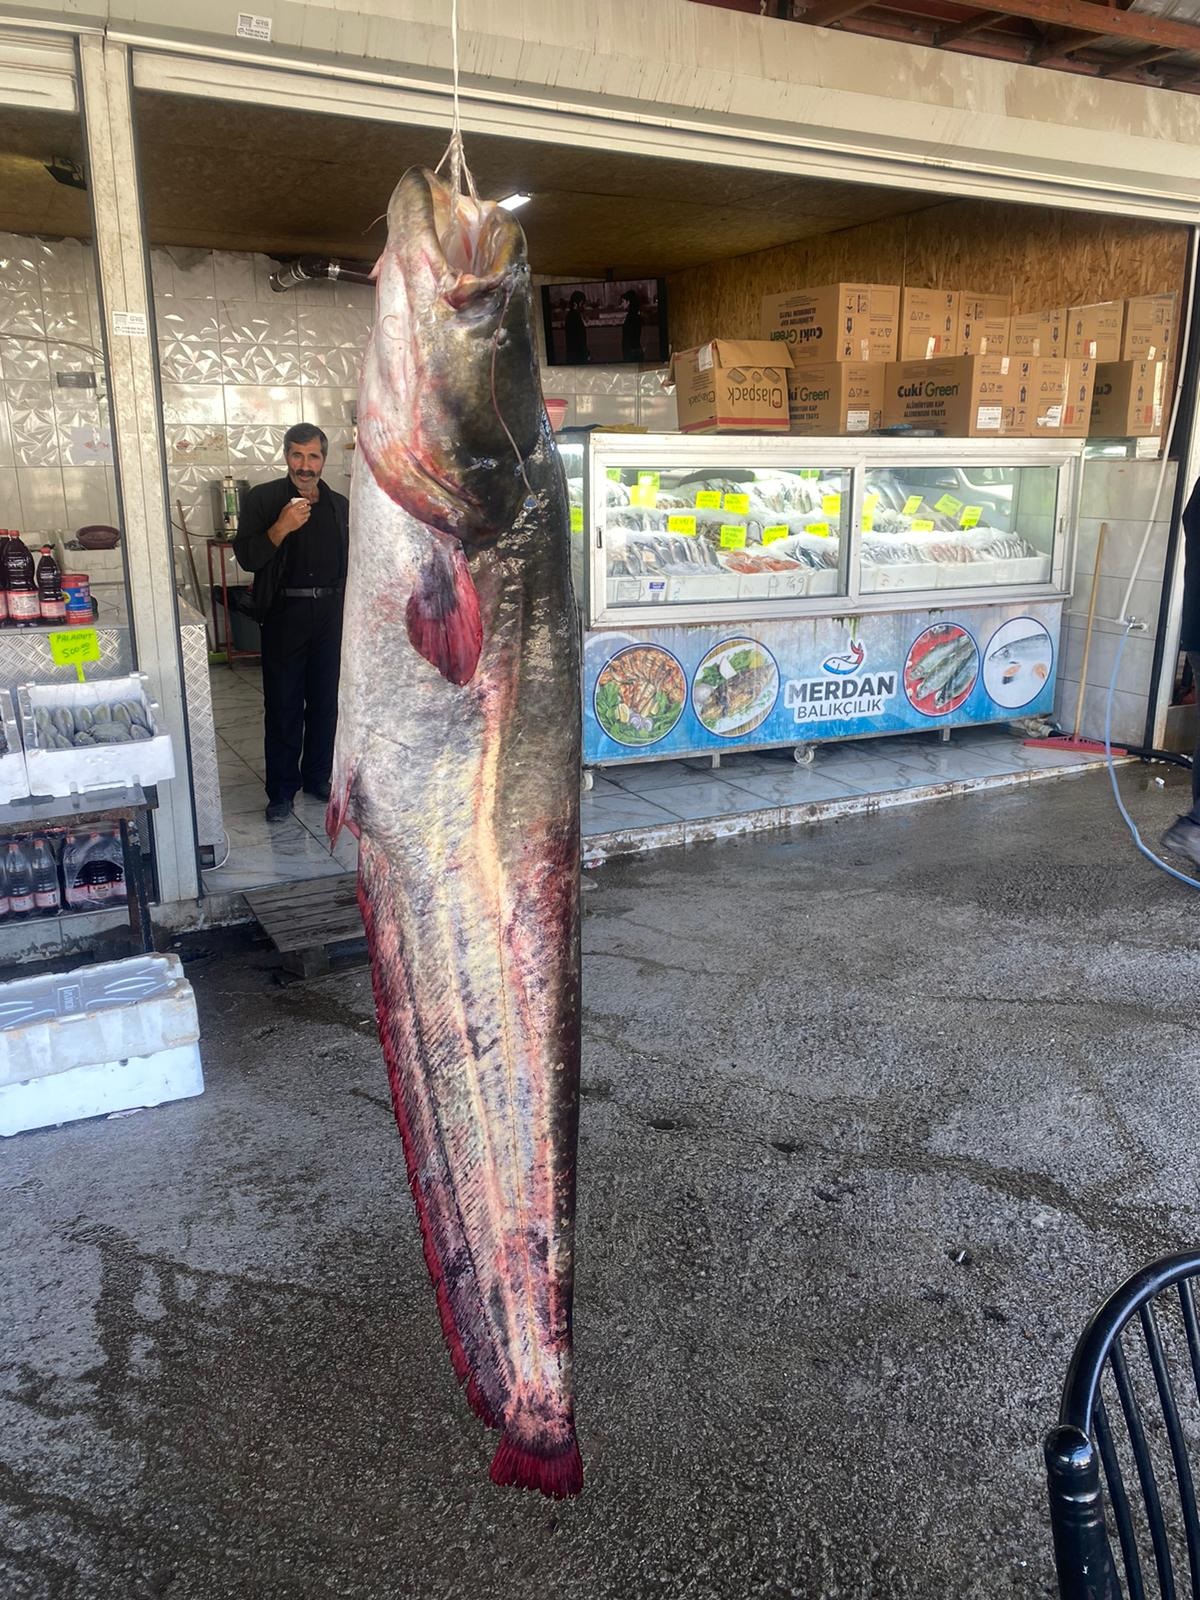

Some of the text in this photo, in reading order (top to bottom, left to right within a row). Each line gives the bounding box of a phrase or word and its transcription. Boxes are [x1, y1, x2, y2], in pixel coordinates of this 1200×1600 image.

[770, 326, 823, 344] Cuki Green
[727, 384, 783, 409] Claspack
[800, 387, 830, 402] Green
[897, 381, 959, 398] Cuki Green
[788, 675, 895, 704] MERDAN
[797, 699, 882, 719] BALIKÇILIK
